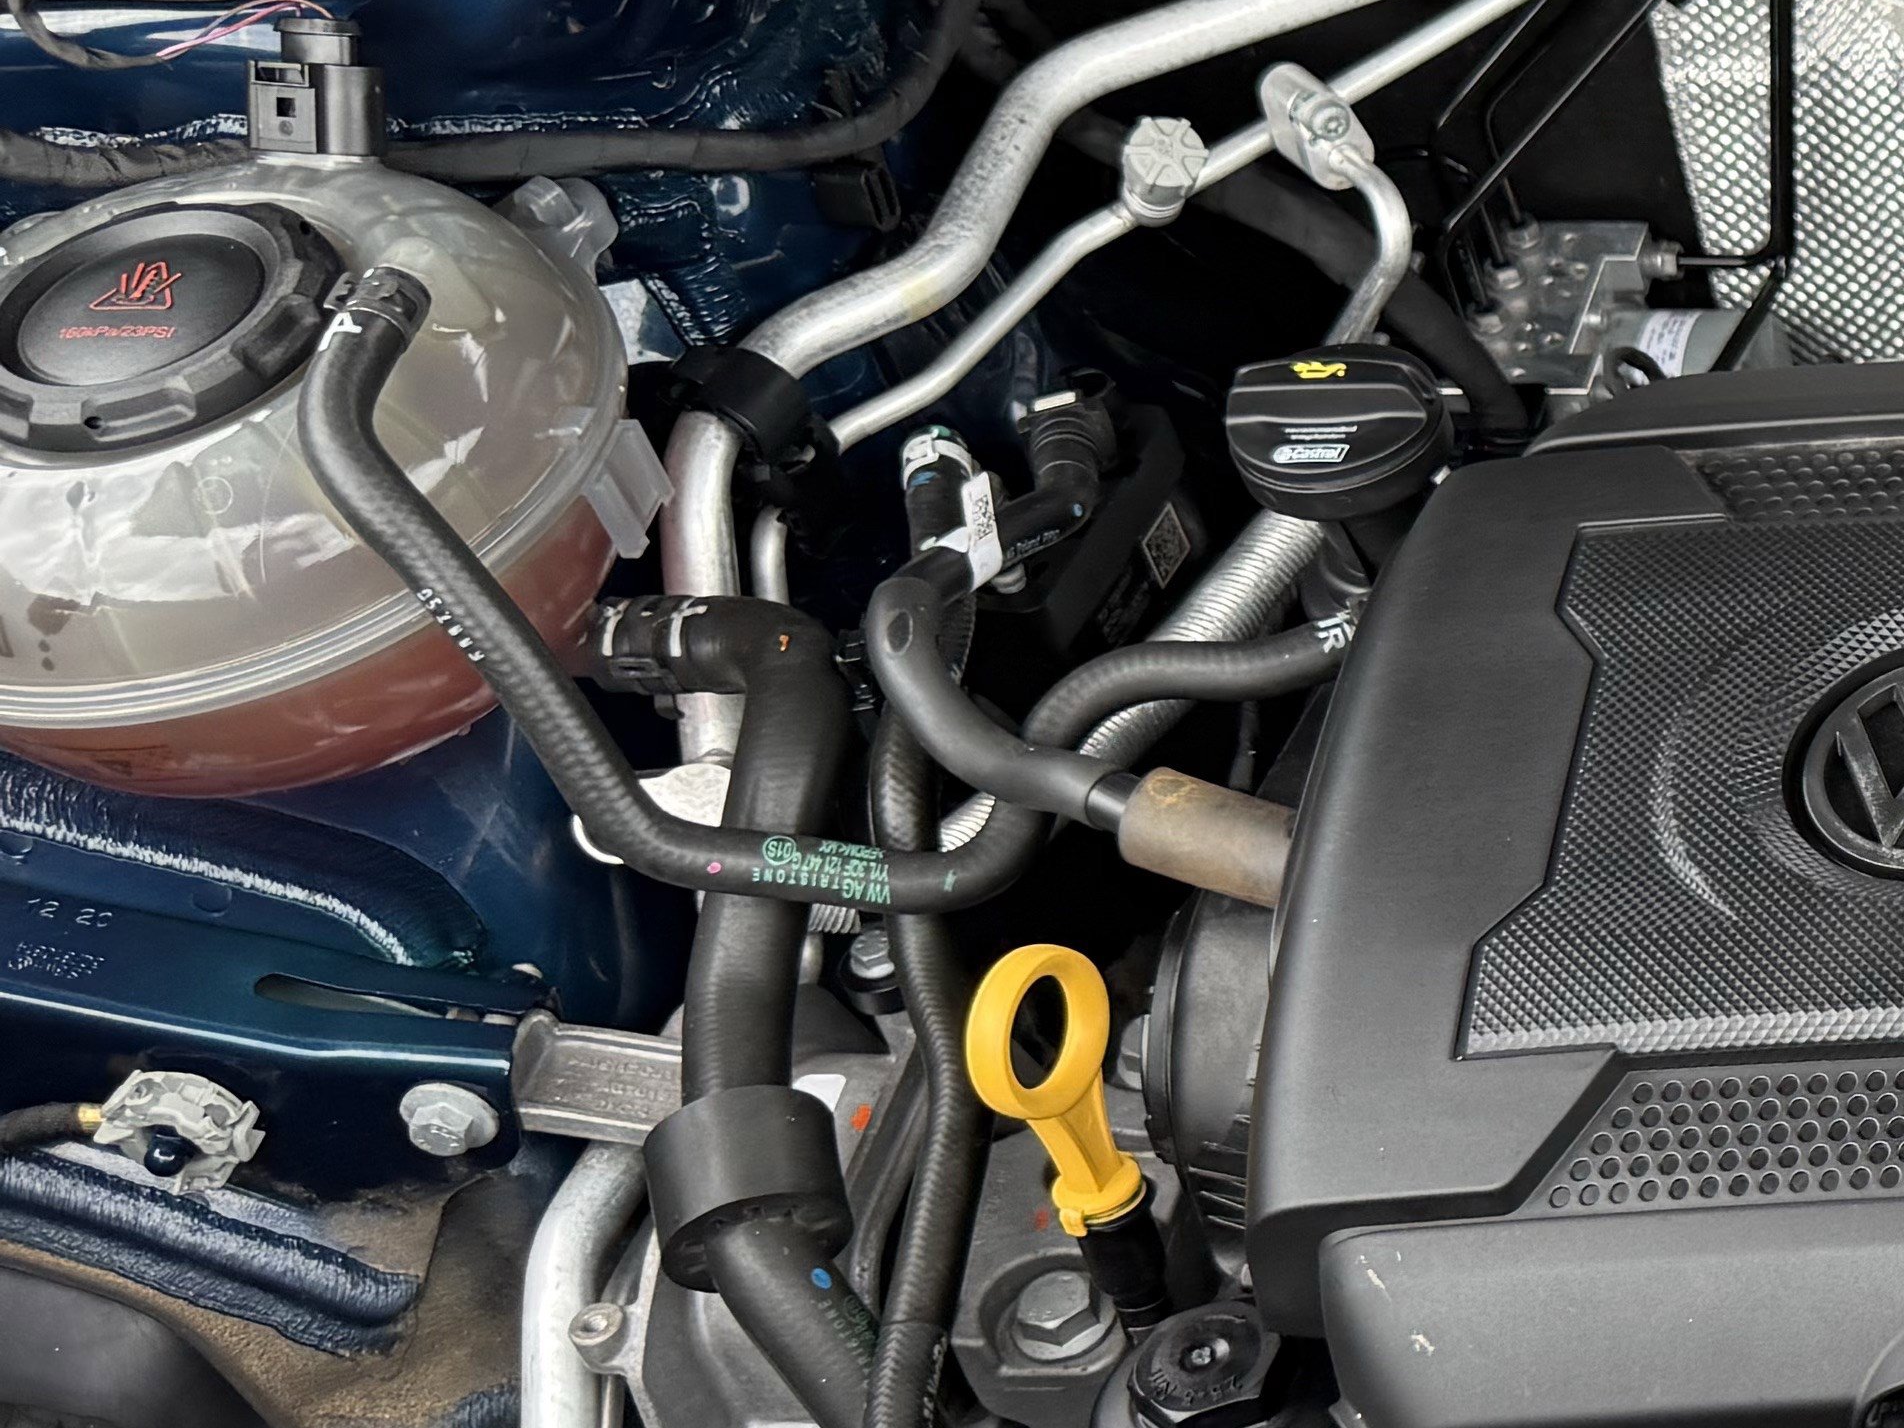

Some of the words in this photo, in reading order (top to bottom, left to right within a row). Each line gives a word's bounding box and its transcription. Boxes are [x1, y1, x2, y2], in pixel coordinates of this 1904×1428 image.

[752, 867, 841, 890] TRISTONE
[842, 878, 867, 900] AG
[866, 882, 891, 905] VW
